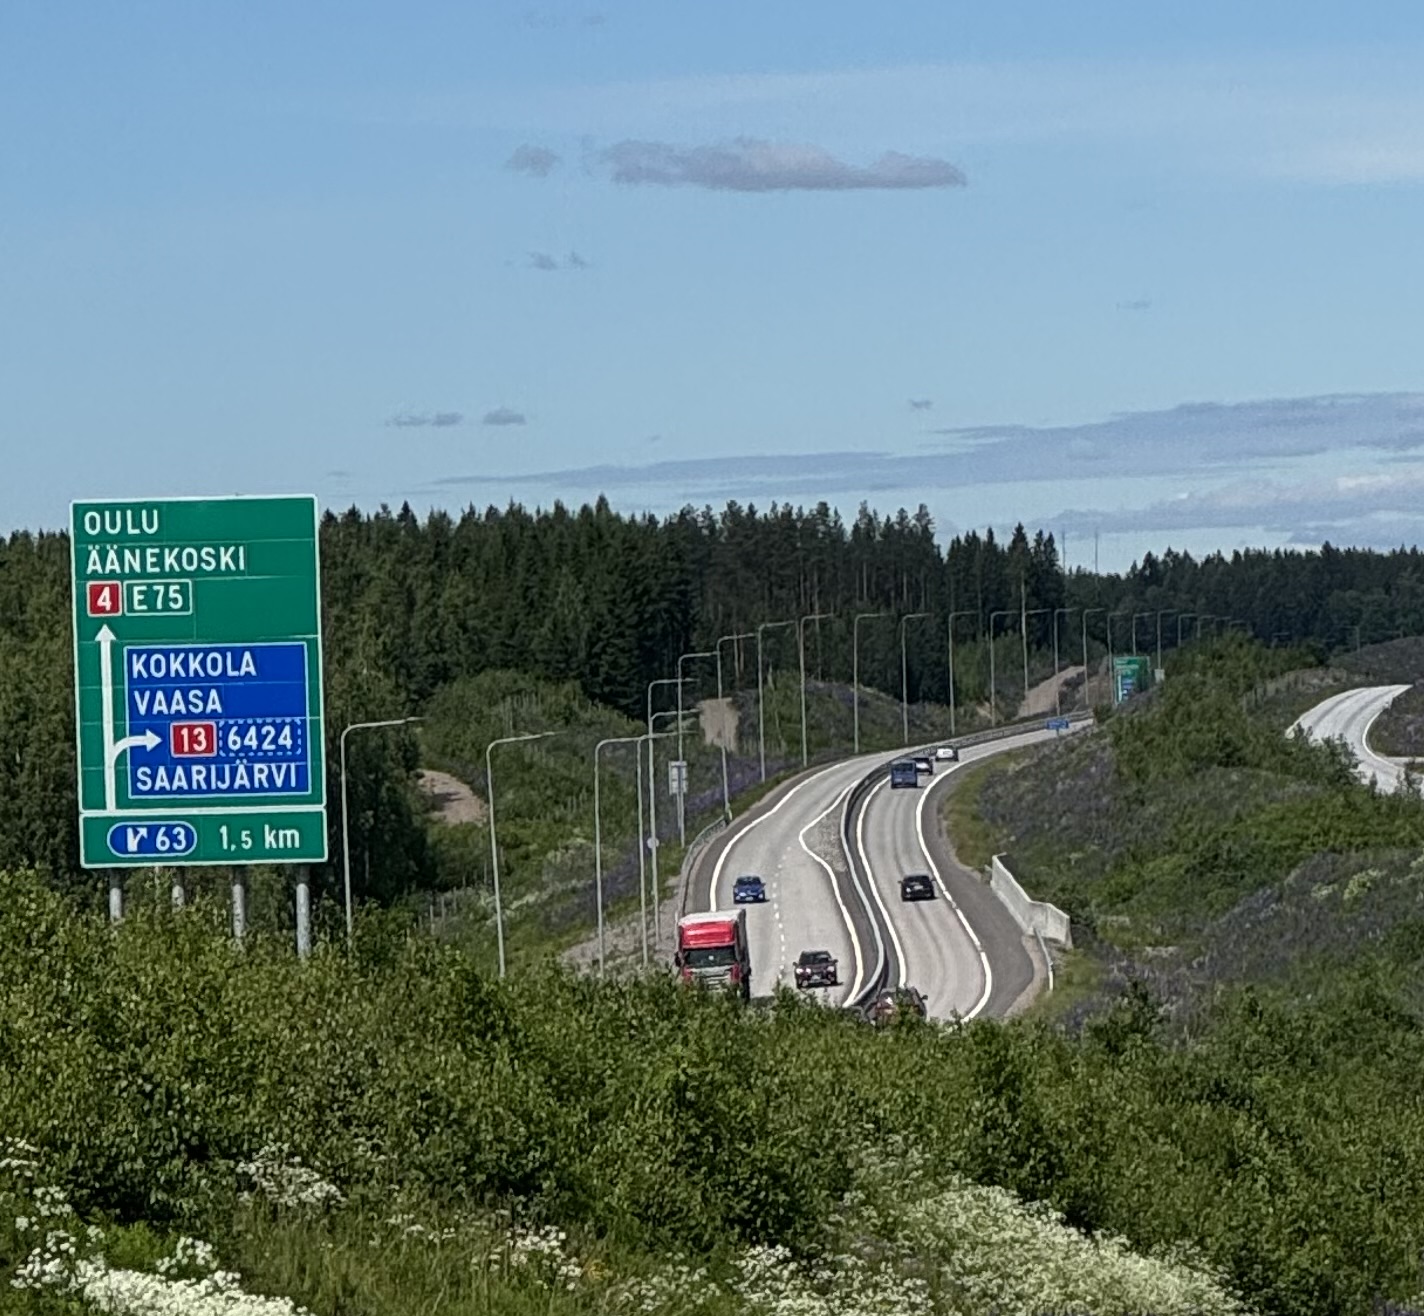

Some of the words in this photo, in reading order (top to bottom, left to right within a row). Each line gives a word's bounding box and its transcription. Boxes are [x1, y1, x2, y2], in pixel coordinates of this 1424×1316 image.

[84, 509, 159, 535] OULU
[86, 545, 245, 575] ÄÄNEKOSKI
[96, 586, 112, 611] 4
[132, 651, 257, 679] KOKKOLA
[134, 688, 222, 716] VAASA
[181, 727, 207, 753] 13
[228, 725, 293, 751] 6424
[136, 758, 296, 791] SAARIJÄRVI
[155, 826, 187, 852] 63
[264, 823, 300, 850] km
